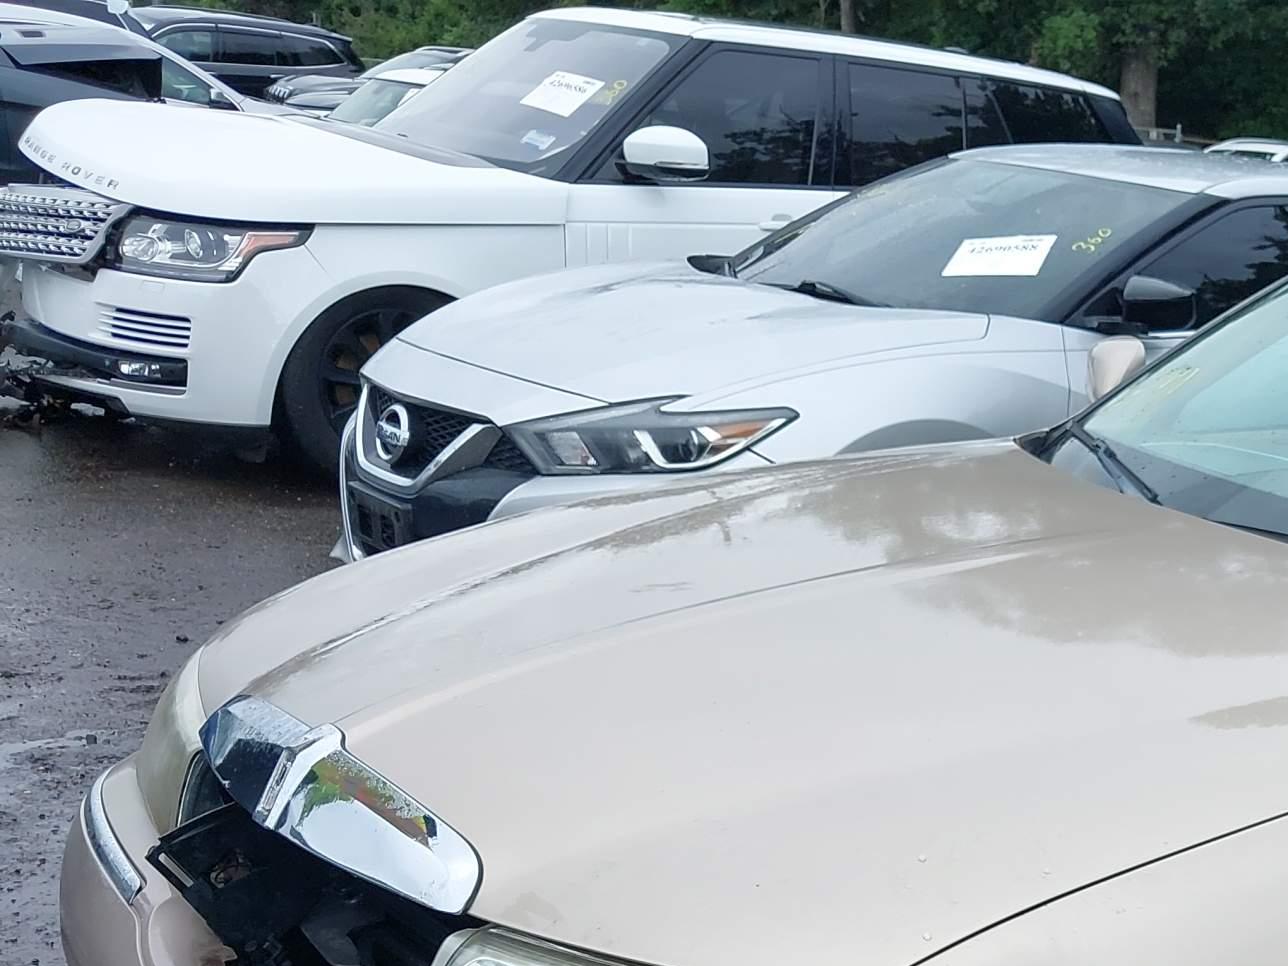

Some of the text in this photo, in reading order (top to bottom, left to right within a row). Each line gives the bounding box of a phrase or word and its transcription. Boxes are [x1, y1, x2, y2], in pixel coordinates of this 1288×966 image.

[24, 136, 120, 191] RANGE ROVER
[1071, 227, 1113, 255] 360
